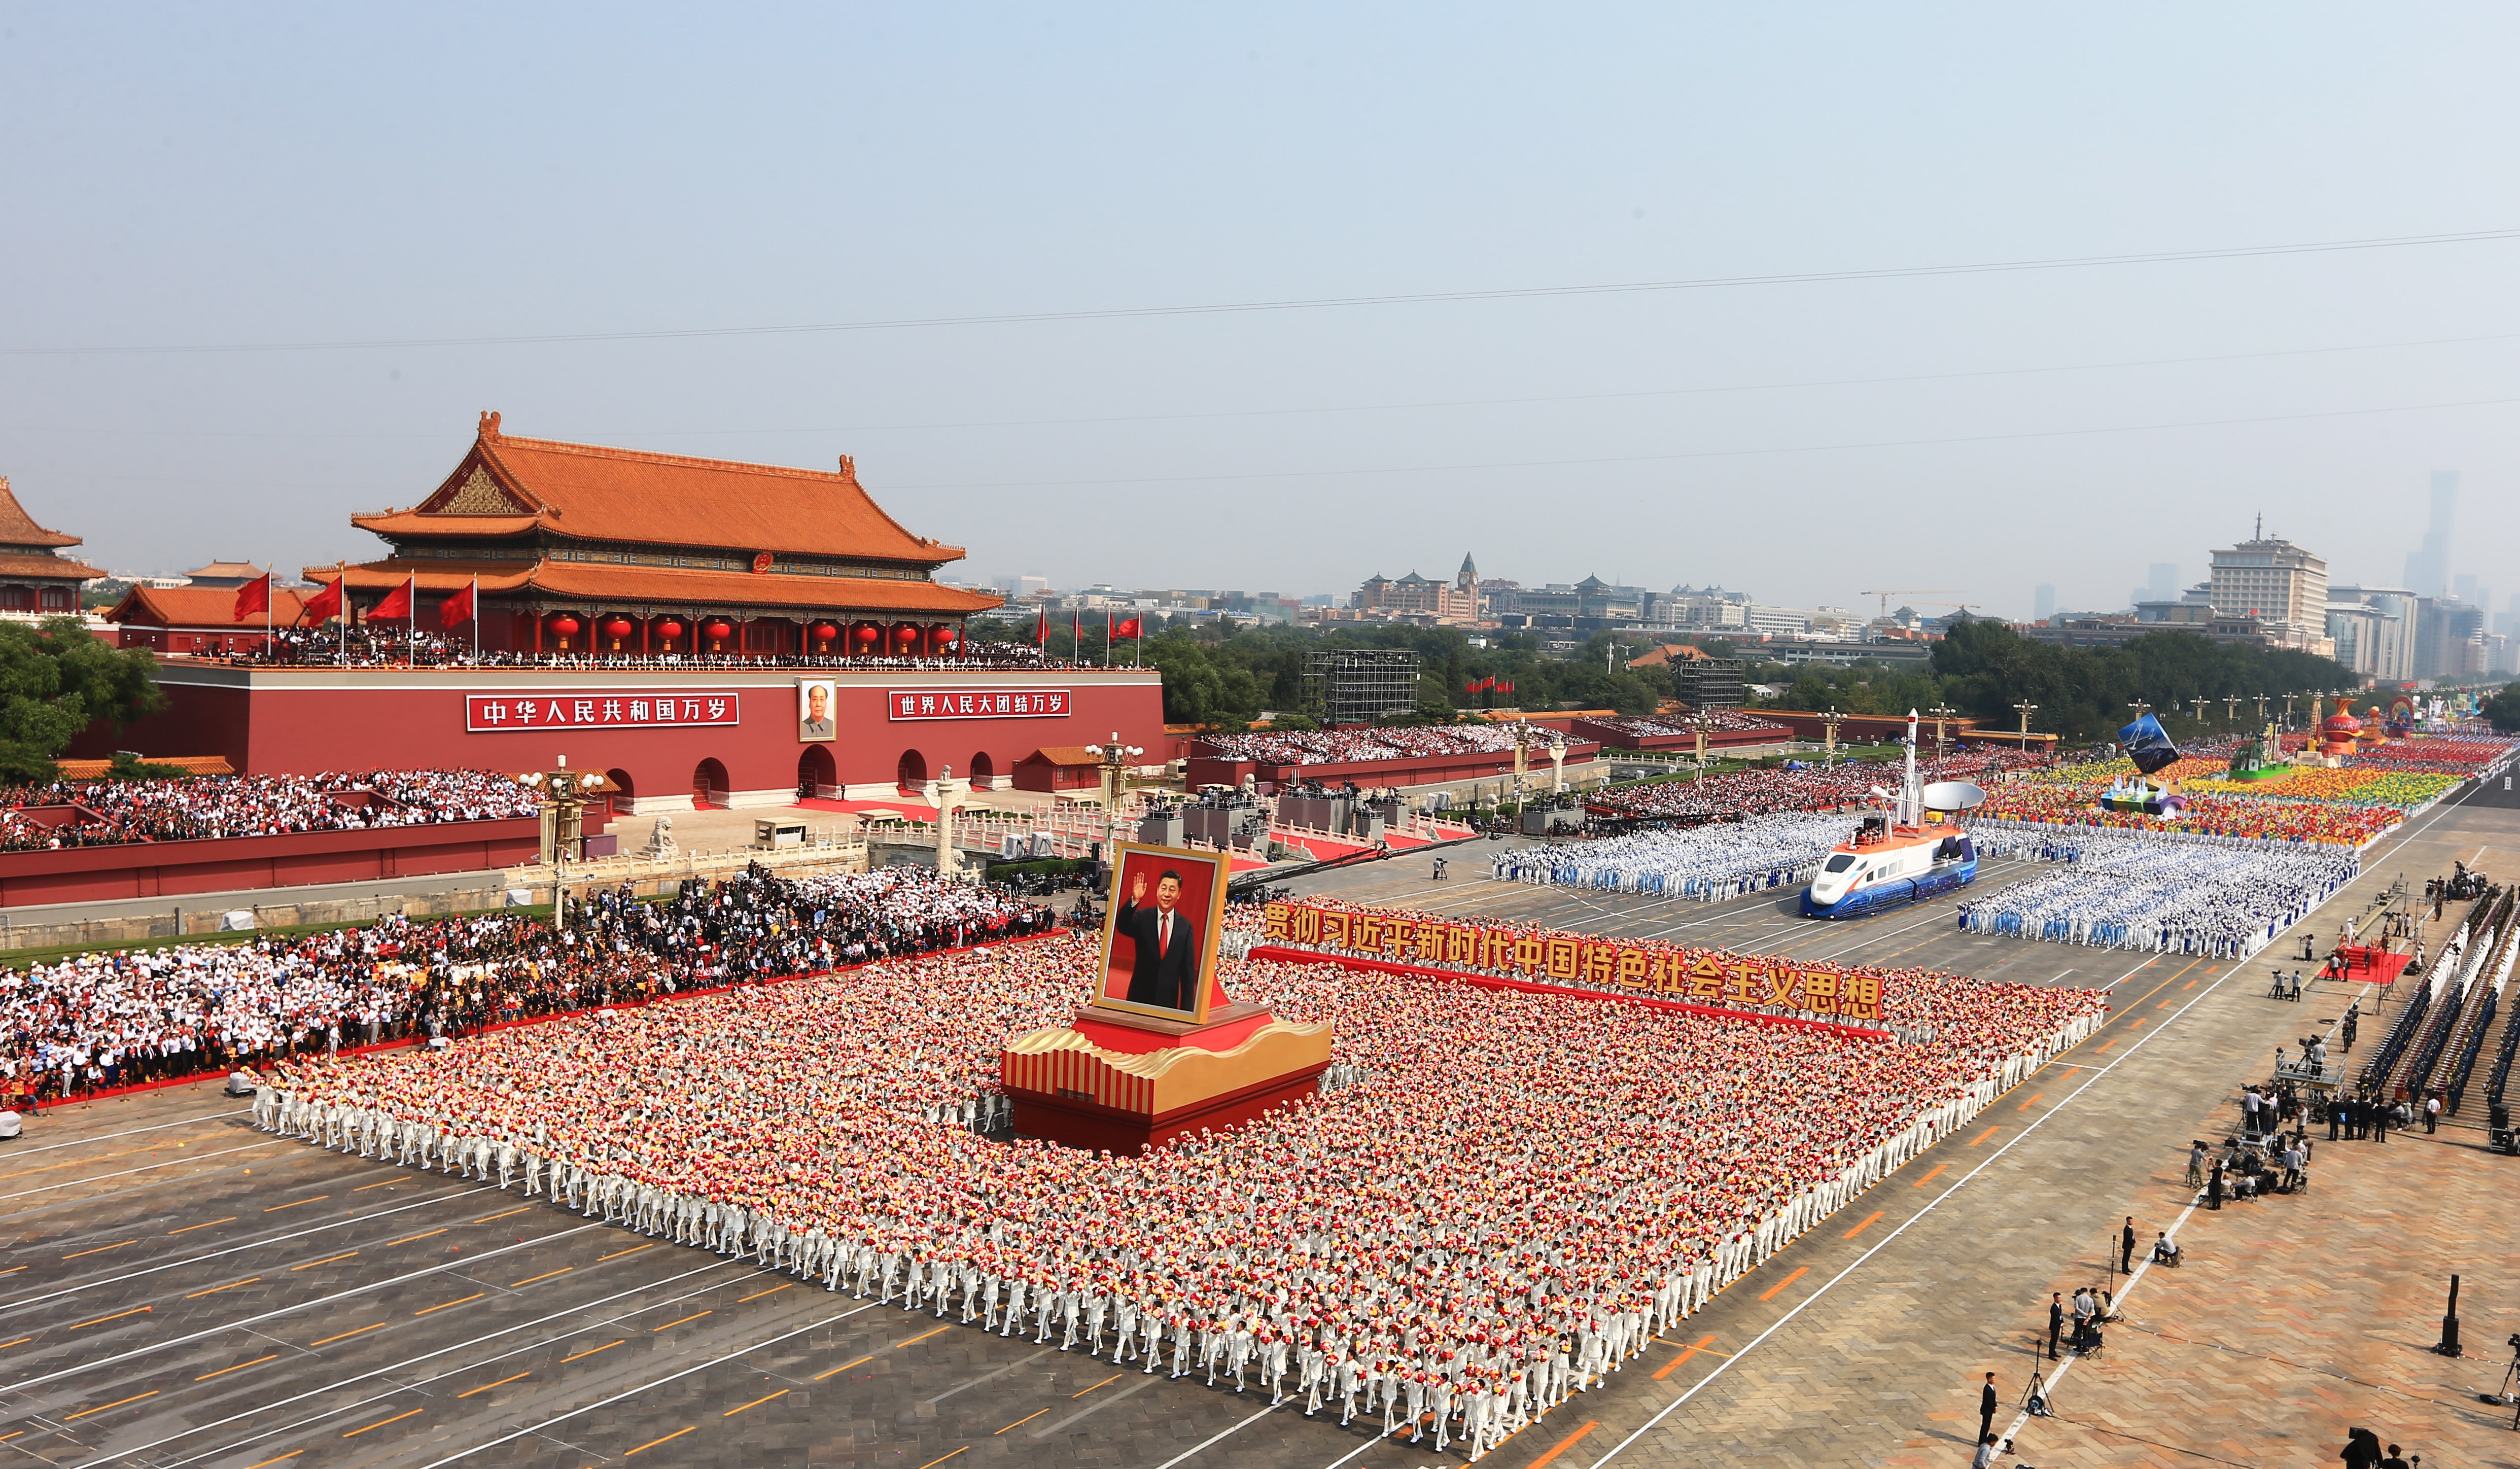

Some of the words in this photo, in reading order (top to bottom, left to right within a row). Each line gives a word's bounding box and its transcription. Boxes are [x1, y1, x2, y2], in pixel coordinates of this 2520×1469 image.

[483, 698, 726, 725] 中华人民共和国万岁
[901, 694, 1062, 715] 世界人民大团结万岁
[1265, 903, 1879, 1019] 贯彻习近平新时代中国特色社会主义思想
